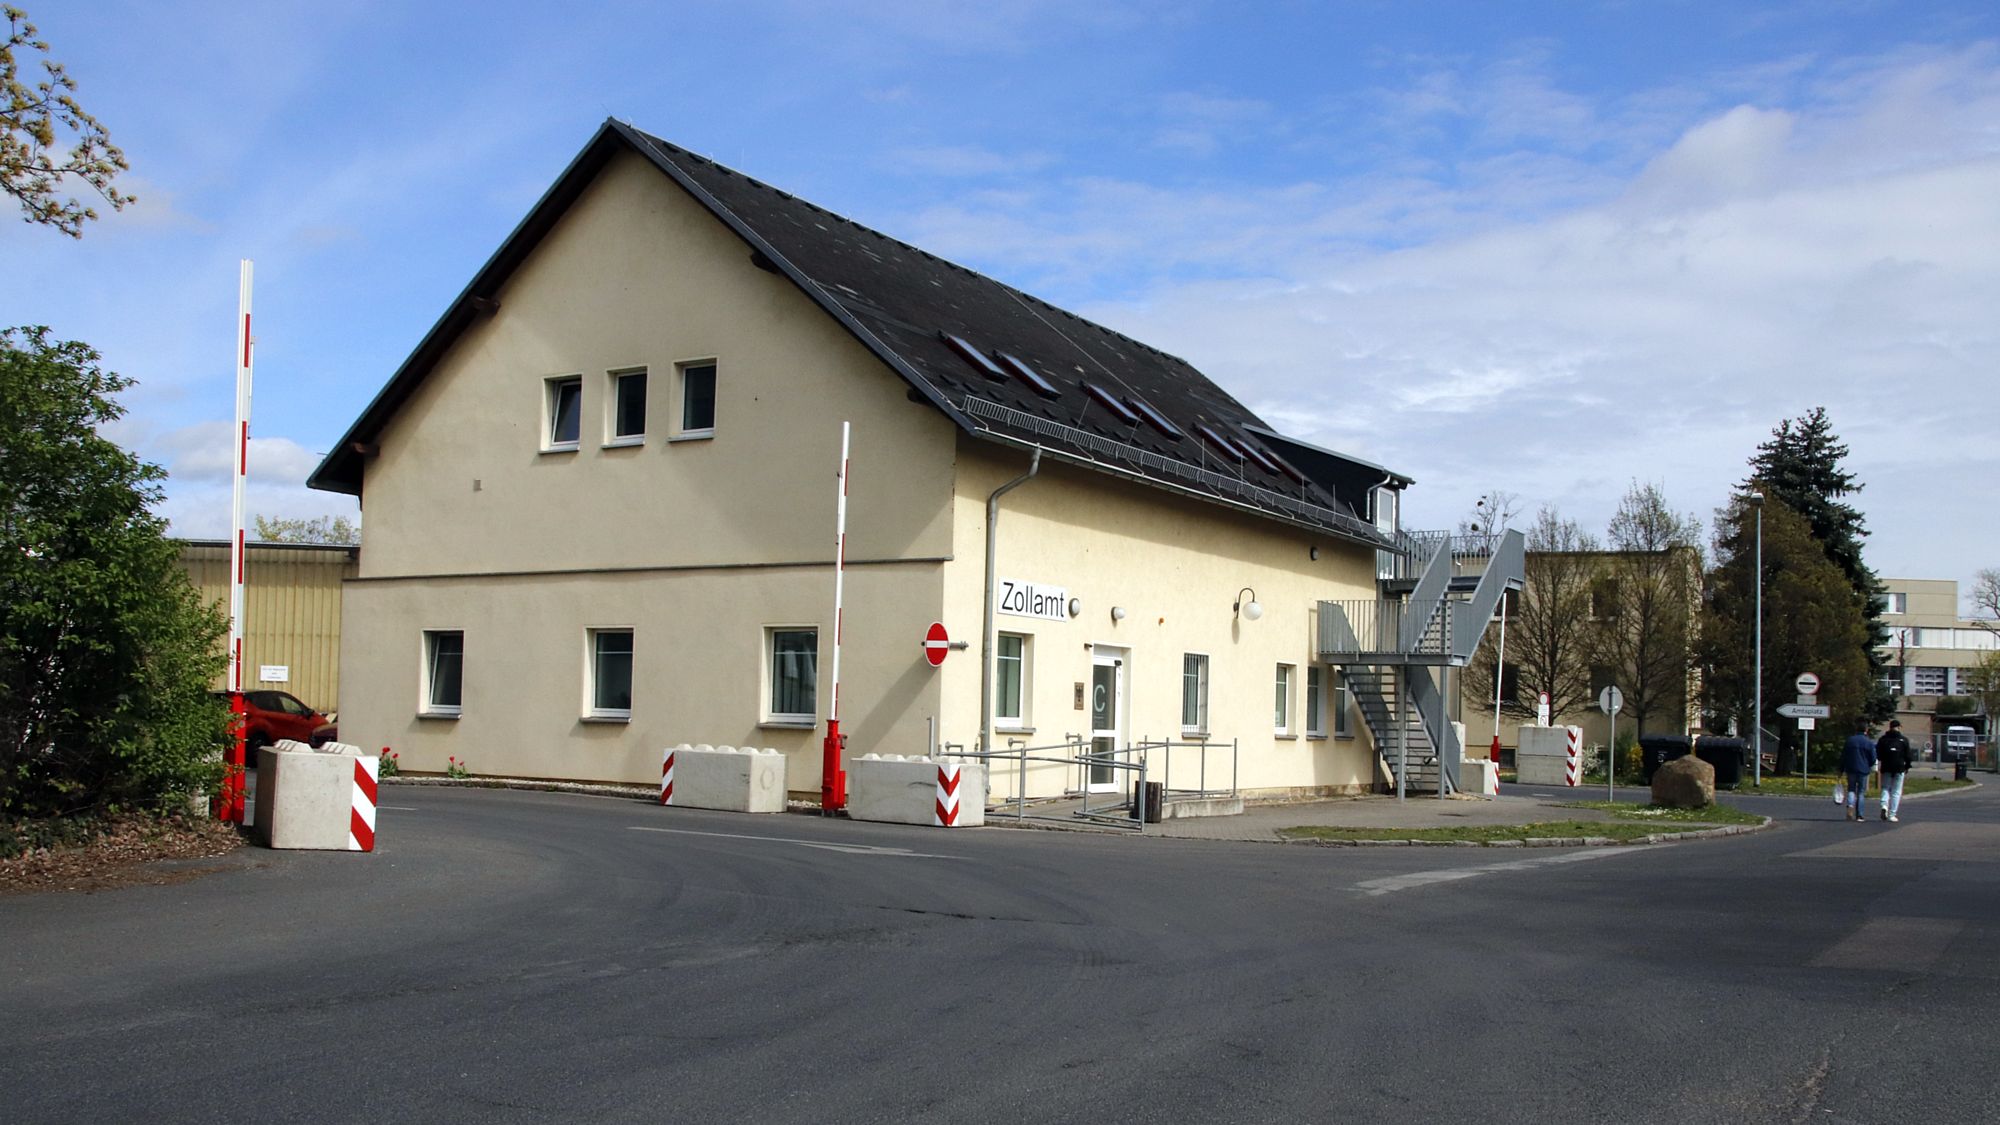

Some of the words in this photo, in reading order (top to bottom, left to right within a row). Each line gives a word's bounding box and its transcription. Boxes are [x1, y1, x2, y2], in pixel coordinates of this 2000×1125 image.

[1002, 582, 1064, 618] Zollamt
[1094, 684, 1105, 712] C
[1791, 707, 1823, 716] Amtsplatz
